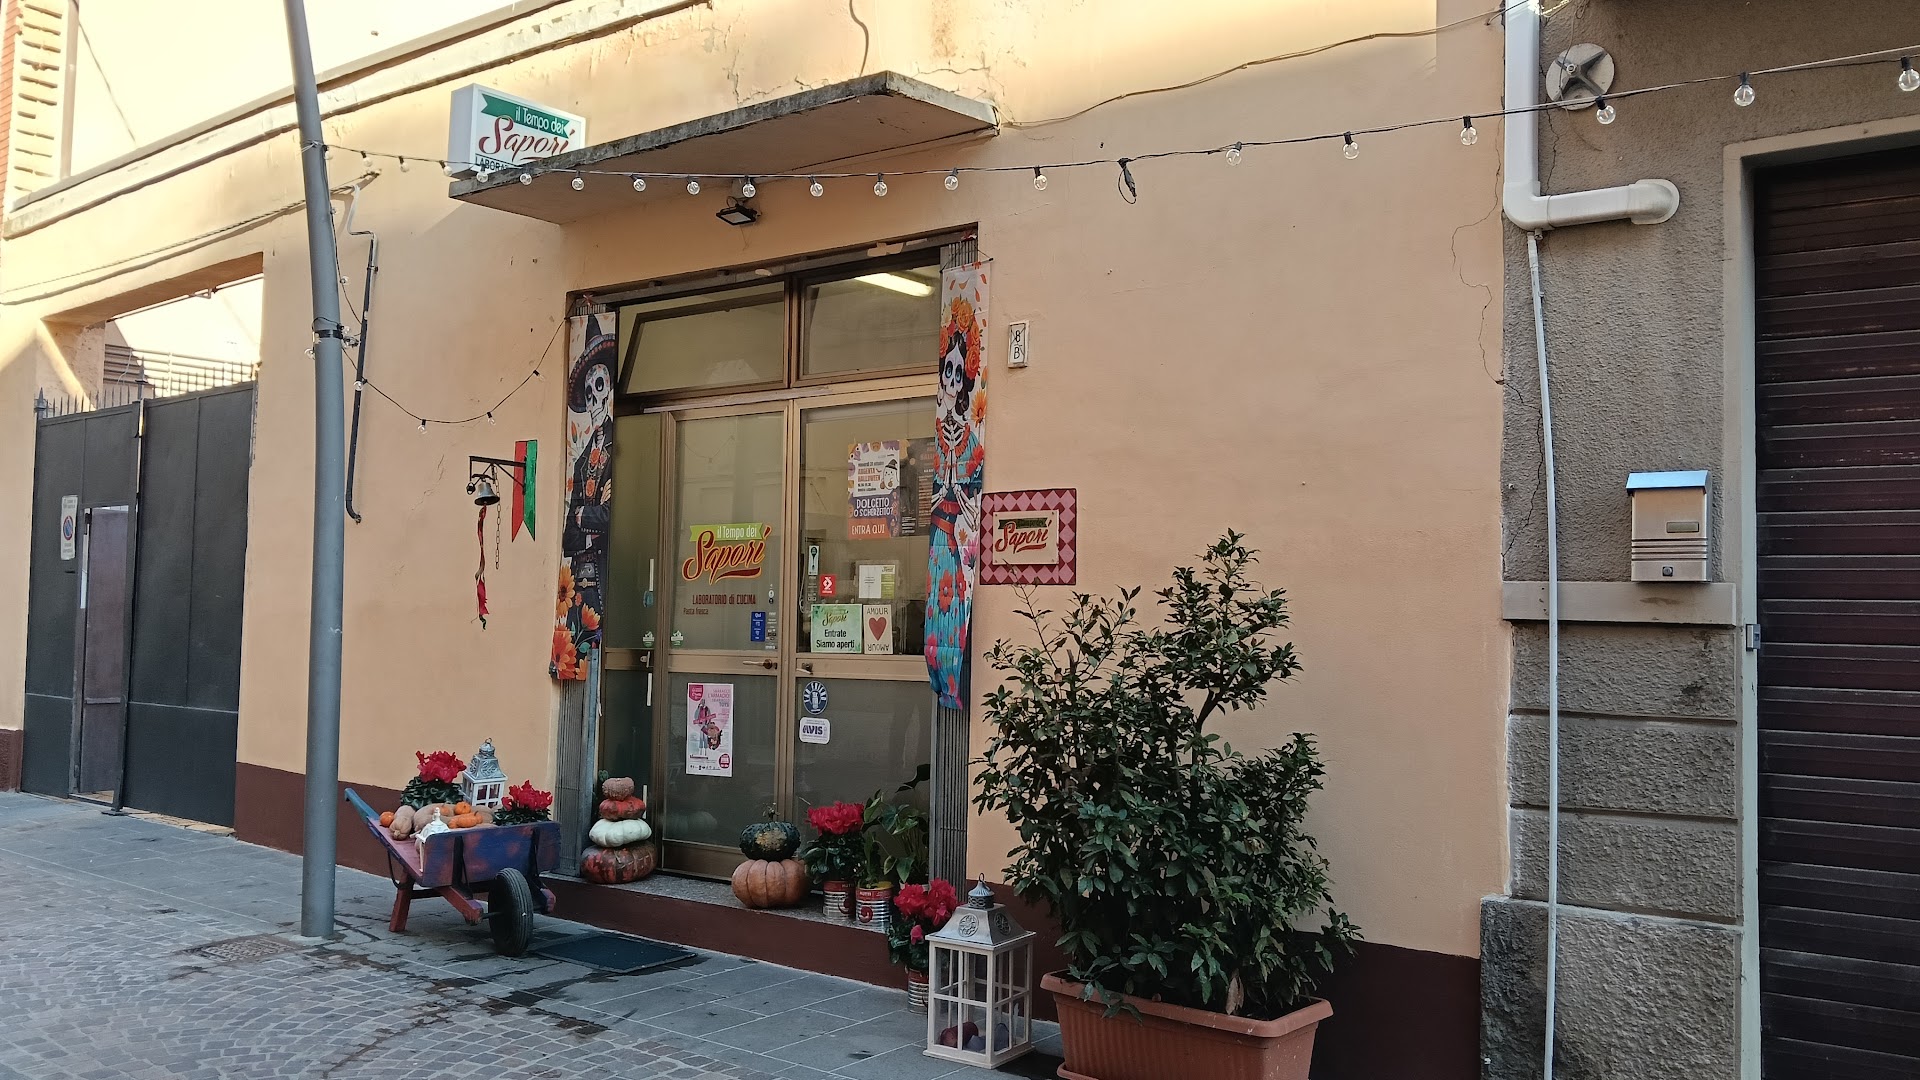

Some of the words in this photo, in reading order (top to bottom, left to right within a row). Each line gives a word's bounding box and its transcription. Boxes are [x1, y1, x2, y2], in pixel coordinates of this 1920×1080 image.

[515, 106, 520, 122] il
[523, 107, 549, 132] Tempo
[551, 120, 564, 135] dei
[478, 115, 576, 162] Sapori
[1013, 346, 1021, 360] B
[856, 497, 890, 509] DOLCETTO
[717, 525, 722, 538] il
[722, 525, 745, 540] Tempo
[746, 525, 757, 537] dei
[851, 525, 871, 535] ENTRA
[872, 524, 885, 534] QUI
[994, 519, 1052, 554] Sapori
[682, 525, 772, 585] Sapori
[692, 594, 727, 605] LABORATORIO
[729, 594, 735, 605] di
[736, 594, 757, 605] CUCINA
[695, 607, 709, 615] fresca
[867, 607, 889, 615] AMOUR
[824, 629, 847, 638] Entrate
[816, 639, 836, 648] Siamo
[836, 639, 855, 649] aperti
[868, 644, 889, 652] AMOUR
[802, 724, 823, 736] AVIS
